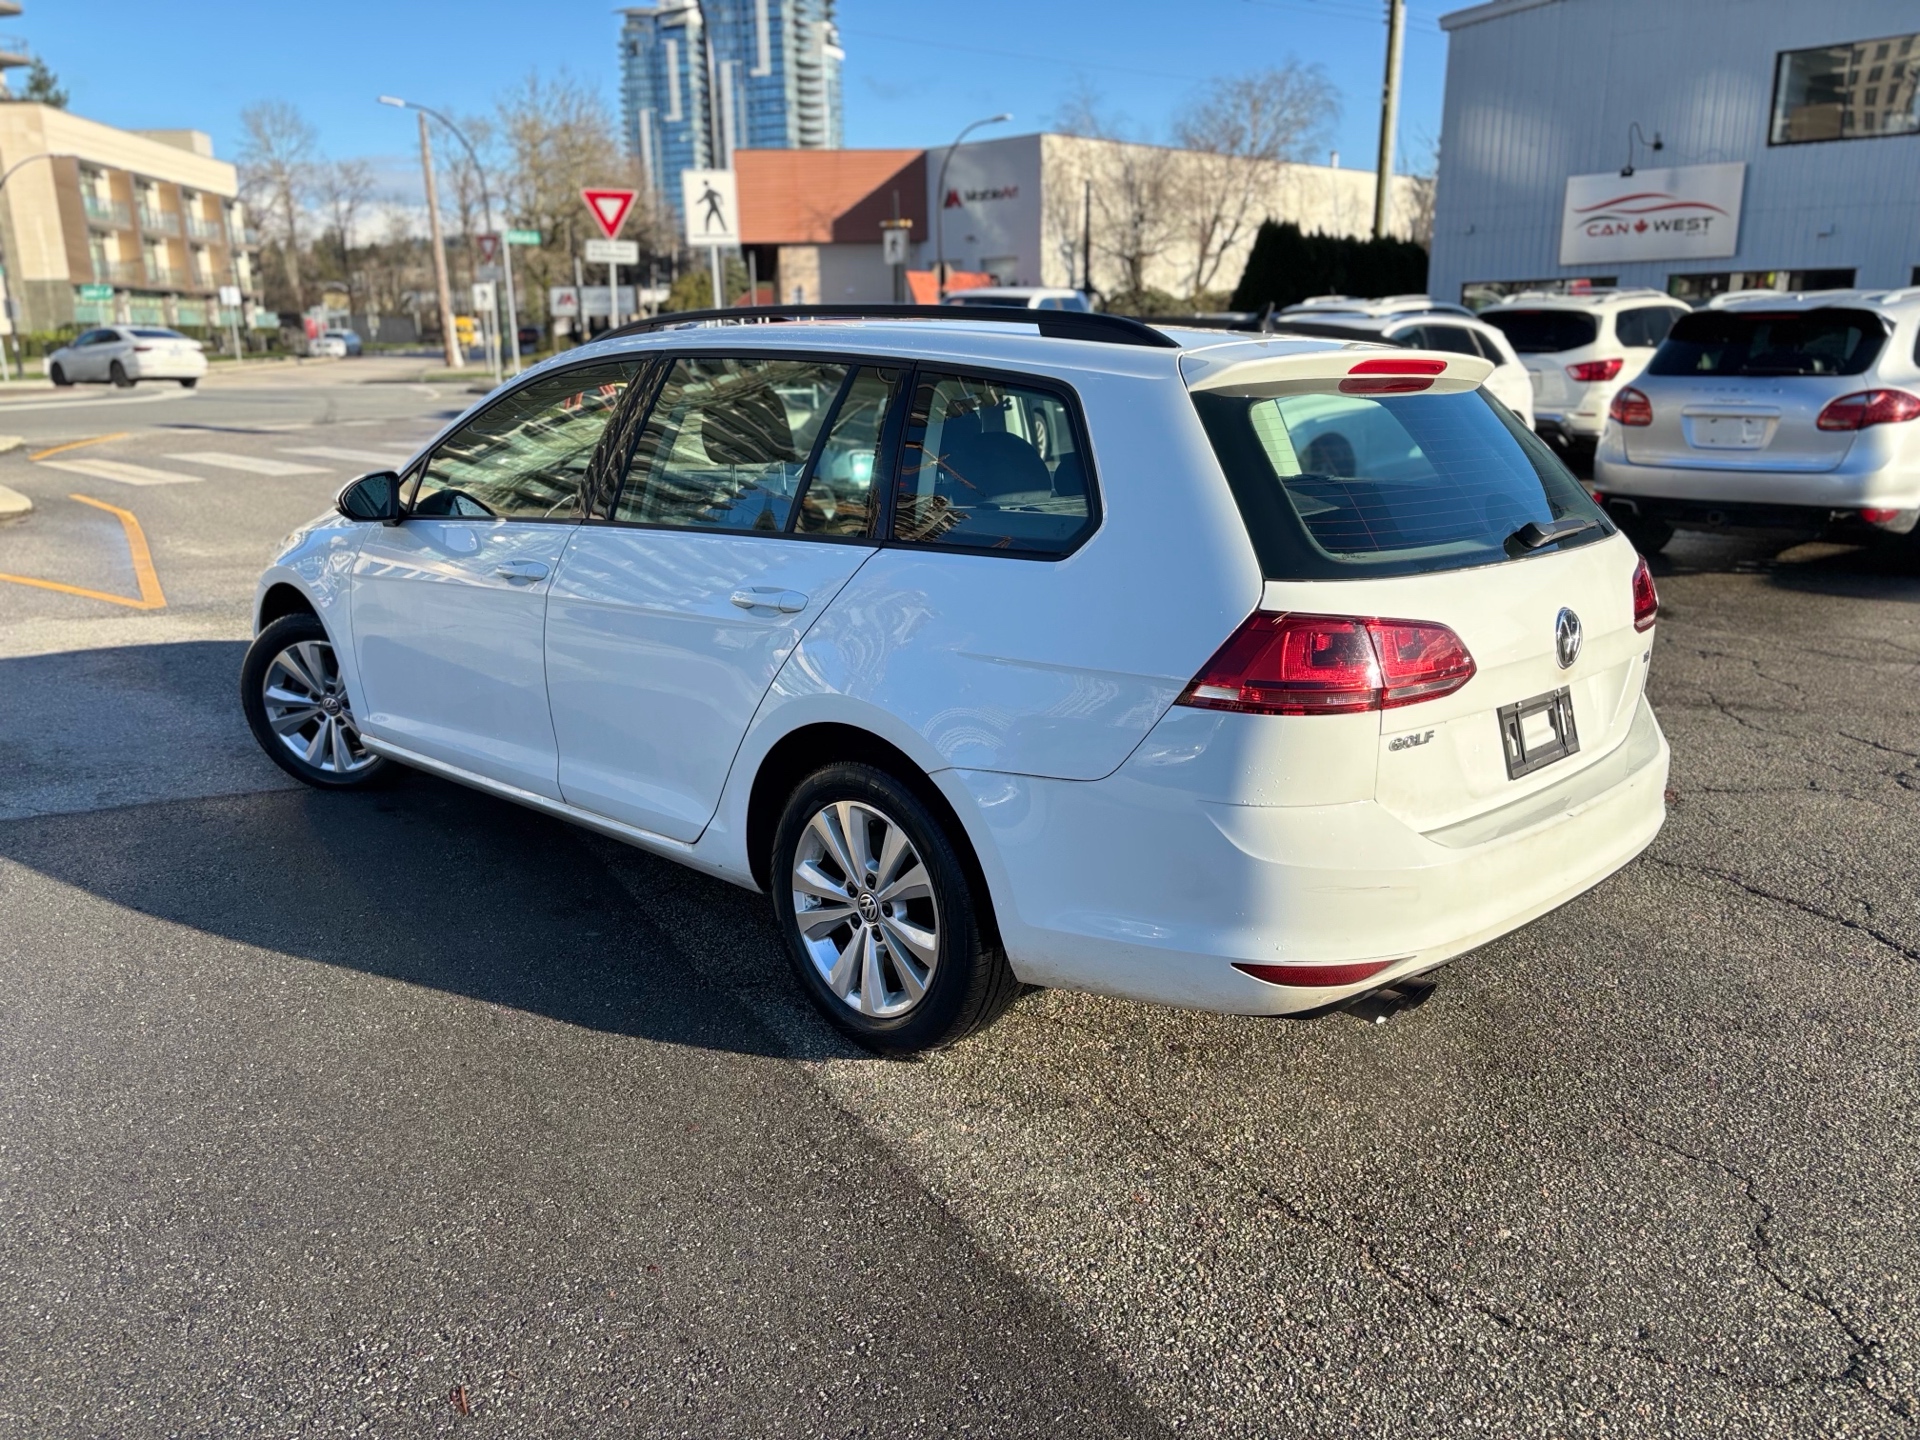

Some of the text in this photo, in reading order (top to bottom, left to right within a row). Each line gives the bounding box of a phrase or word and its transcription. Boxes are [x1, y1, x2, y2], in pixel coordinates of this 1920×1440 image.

[1586, 216, 1714, 237] CAN WEST
[1388, 729, 1435, 752] GOLF
